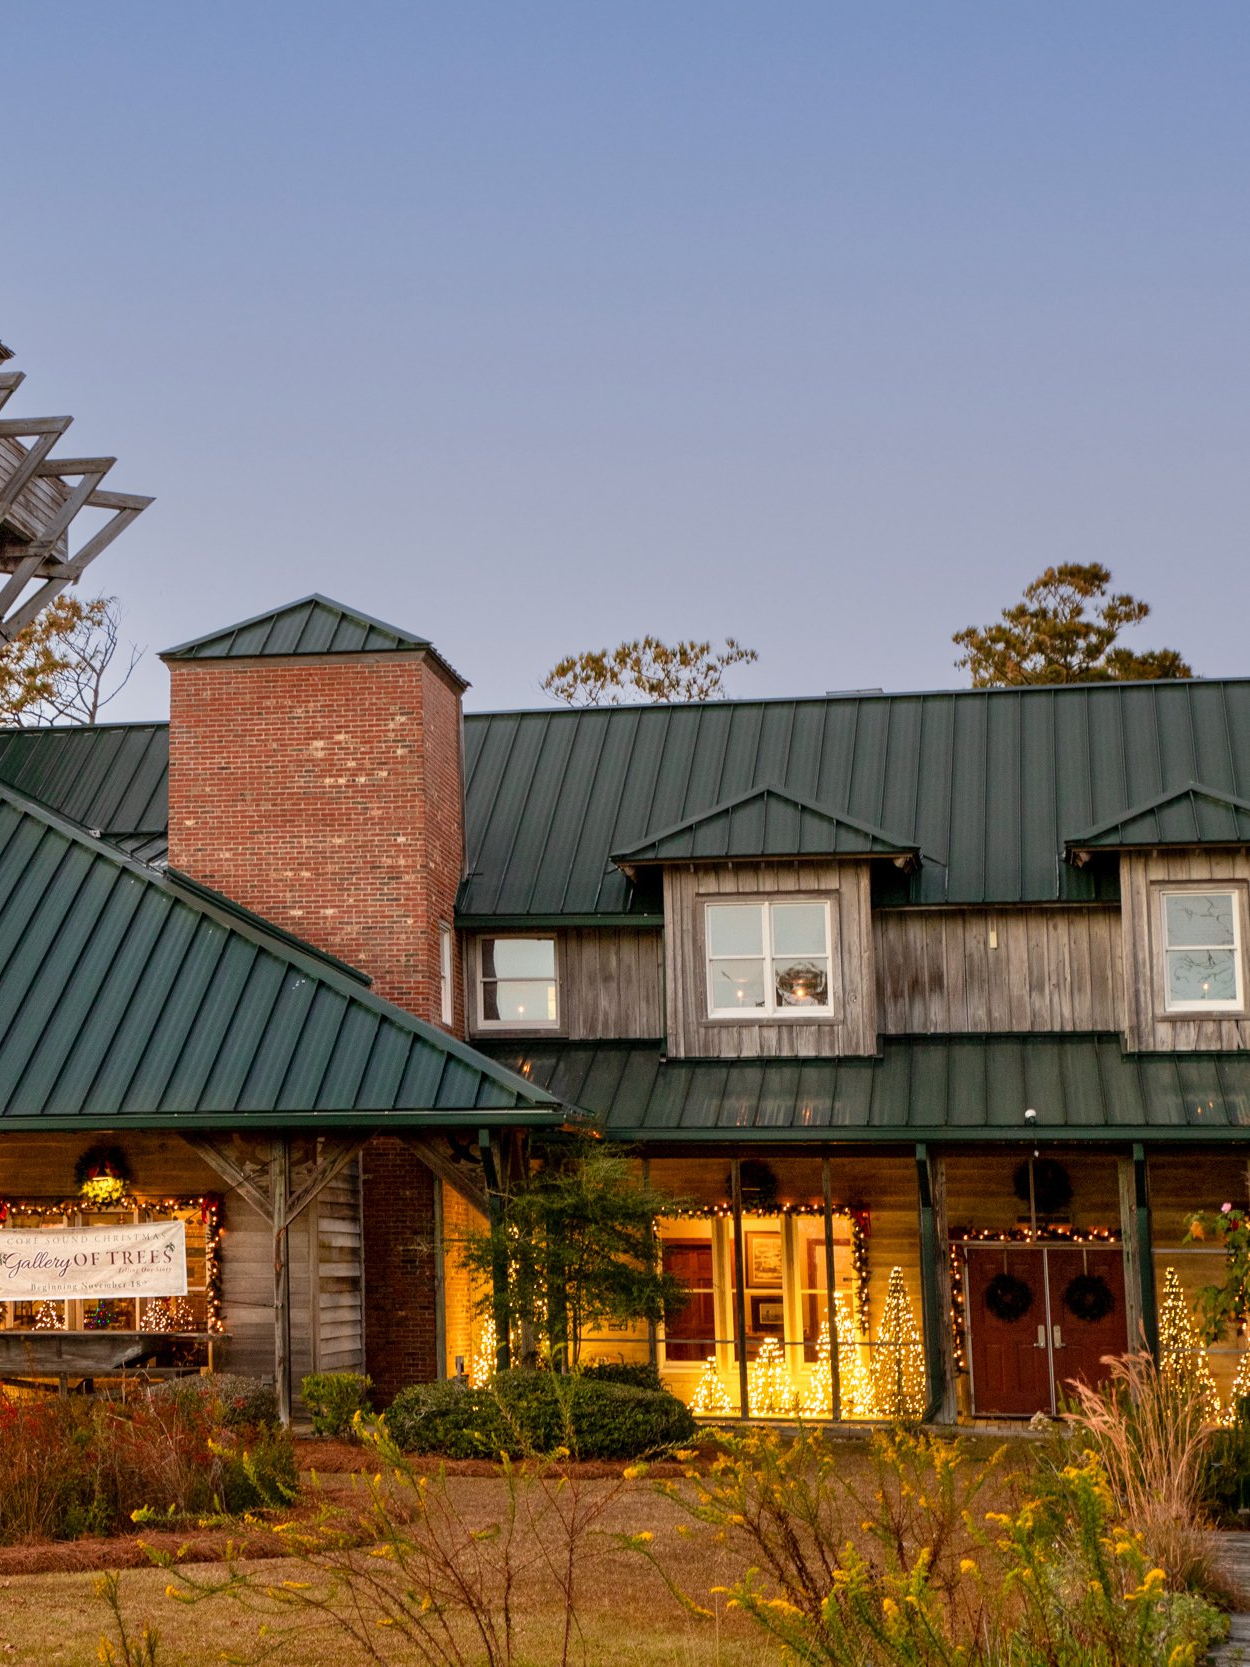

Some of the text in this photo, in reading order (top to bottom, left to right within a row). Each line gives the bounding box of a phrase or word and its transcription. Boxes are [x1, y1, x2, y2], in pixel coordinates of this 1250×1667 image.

[6, 1231, 167, 1246] CORE SOUND CHRISTMAS
[5, 1249, 172, 1279] Gallery OF TREES
[31, 1283, 78, 1293] Beginning
[81, 1280, 126, 1290] November
